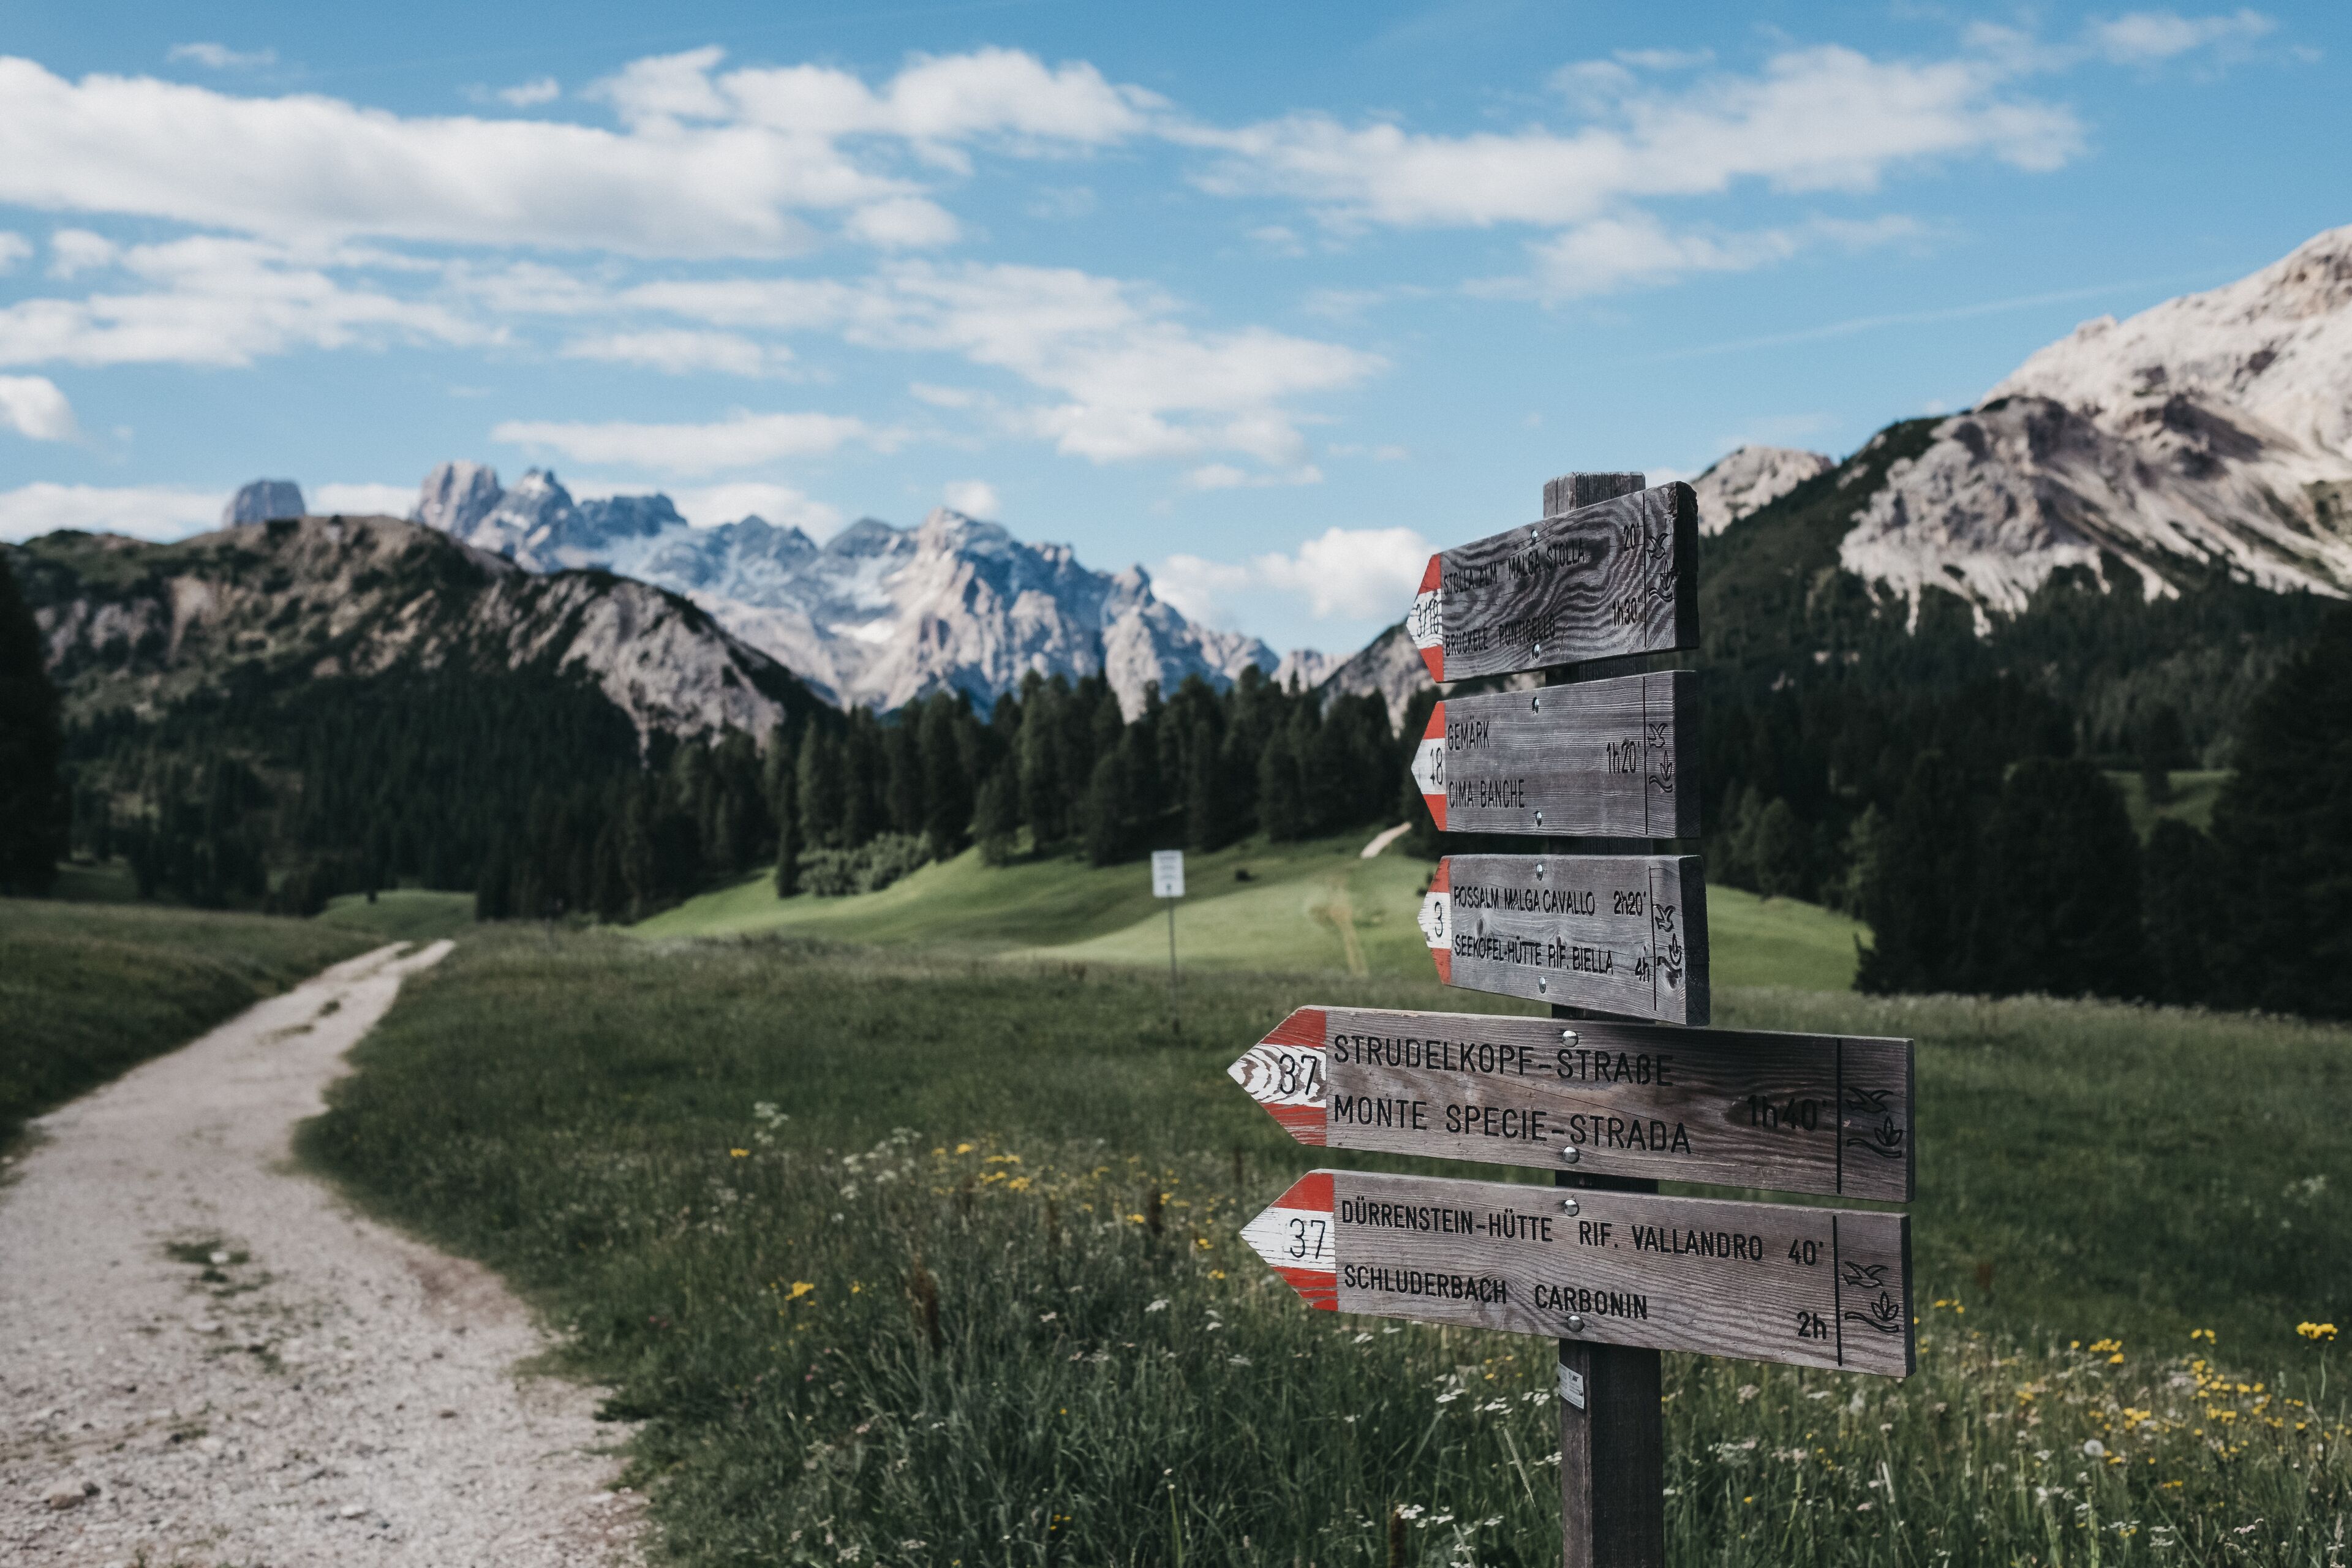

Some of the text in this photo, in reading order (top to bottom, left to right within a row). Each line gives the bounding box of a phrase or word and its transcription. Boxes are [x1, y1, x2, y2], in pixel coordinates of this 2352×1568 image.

[1479, 561, 1498, 588] ALM
[1508, 551, 1542, 581] MALGA
[1547, 538, 1585, 570] STOLLA
[1445, 614, 1556, 657] BRÜCKELE PONTICELLO
[1447, 715, 1490, 751] GEMÄRK
[1429, 746, 1443, 786] 18
[1448, 778, 1525, 809] CIMA BANCHE
[1434, 900, 1444, 938] 3
[1454, 886, 1500, 909] ROSSALM
[1504, 888, 1541, 912] MALGA
[1543, 889, 1595, 917] CAVALLO
[1572, 946, 1614, 976] BIELLA
[1635, 956, 1650, 983] 4h
[1279, 1054, 1317, 1095] 37
[1334, 1095, 1692, 1155] MONTE SPECIE-STRADA
[1289, 1218, 1327, 1259] 37
[1341, 1196, 1824, 1266] DÜRRENSTEIN-HÜTTE RIF. VALLANDRO 40'
[1344, 1264, 1827, 1340] SCHLUDERBACH CARBONIN 2h
